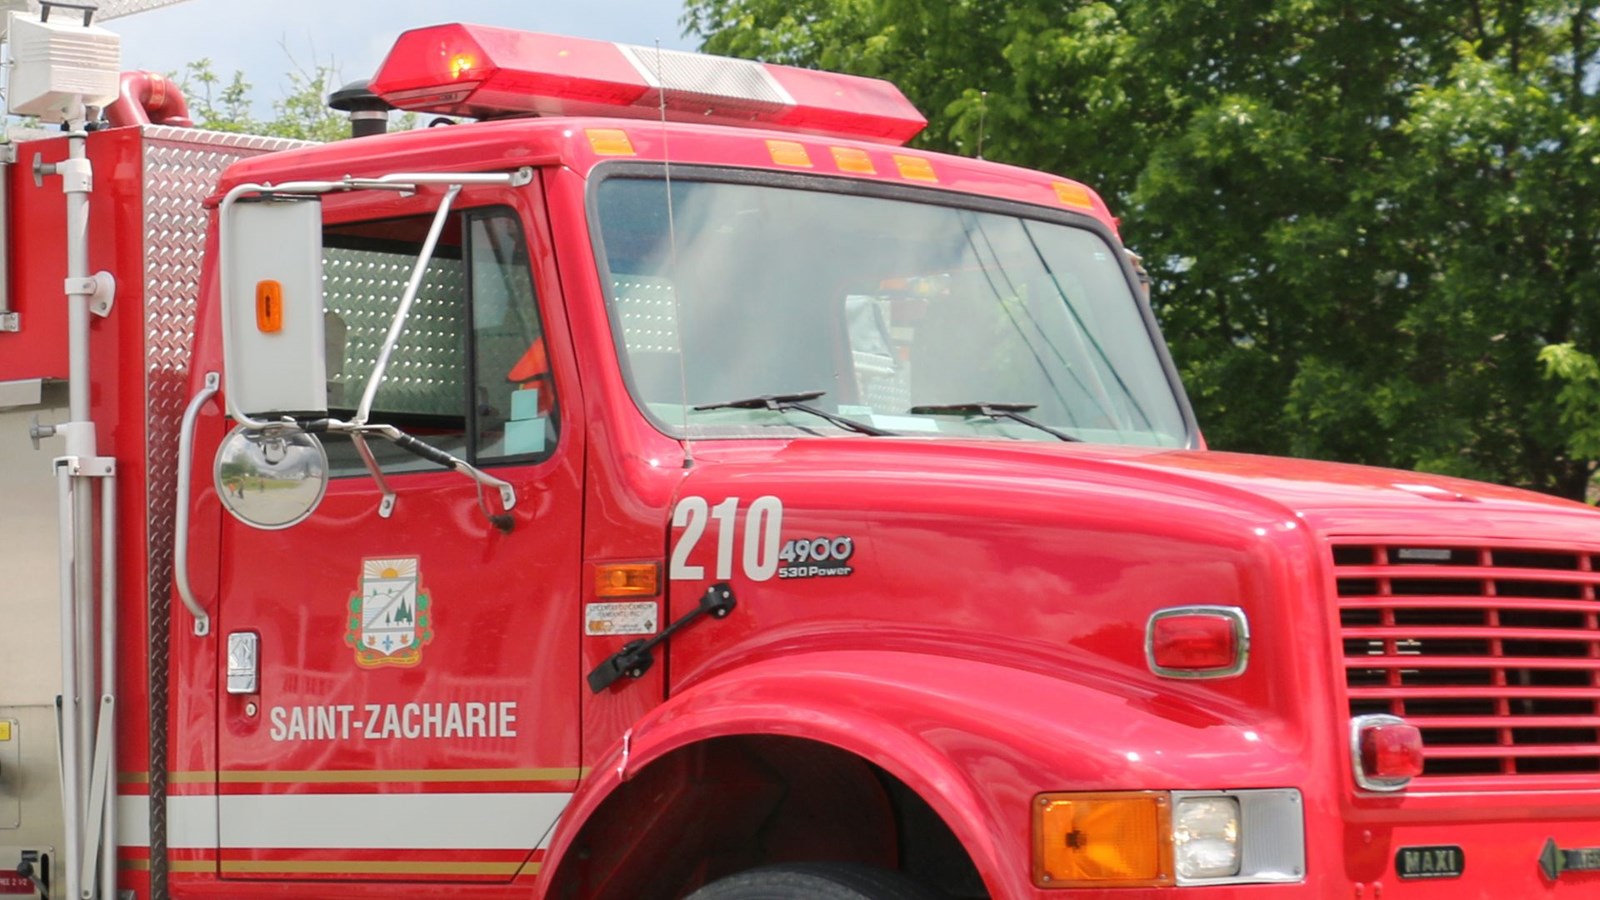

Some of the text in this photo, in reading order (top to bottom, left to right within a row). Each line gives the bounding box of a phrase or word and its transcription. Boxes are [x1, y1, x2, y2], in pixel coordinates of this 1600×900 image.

[669, 495, 783, 581] 210
[778, 537, 852, 562] 4900
[778, 566, 853, 578] 530 Power
[270, 701, 517, 741] SAINT-ZACHARIE
[1404, 850, 1455, 872] MAXI
